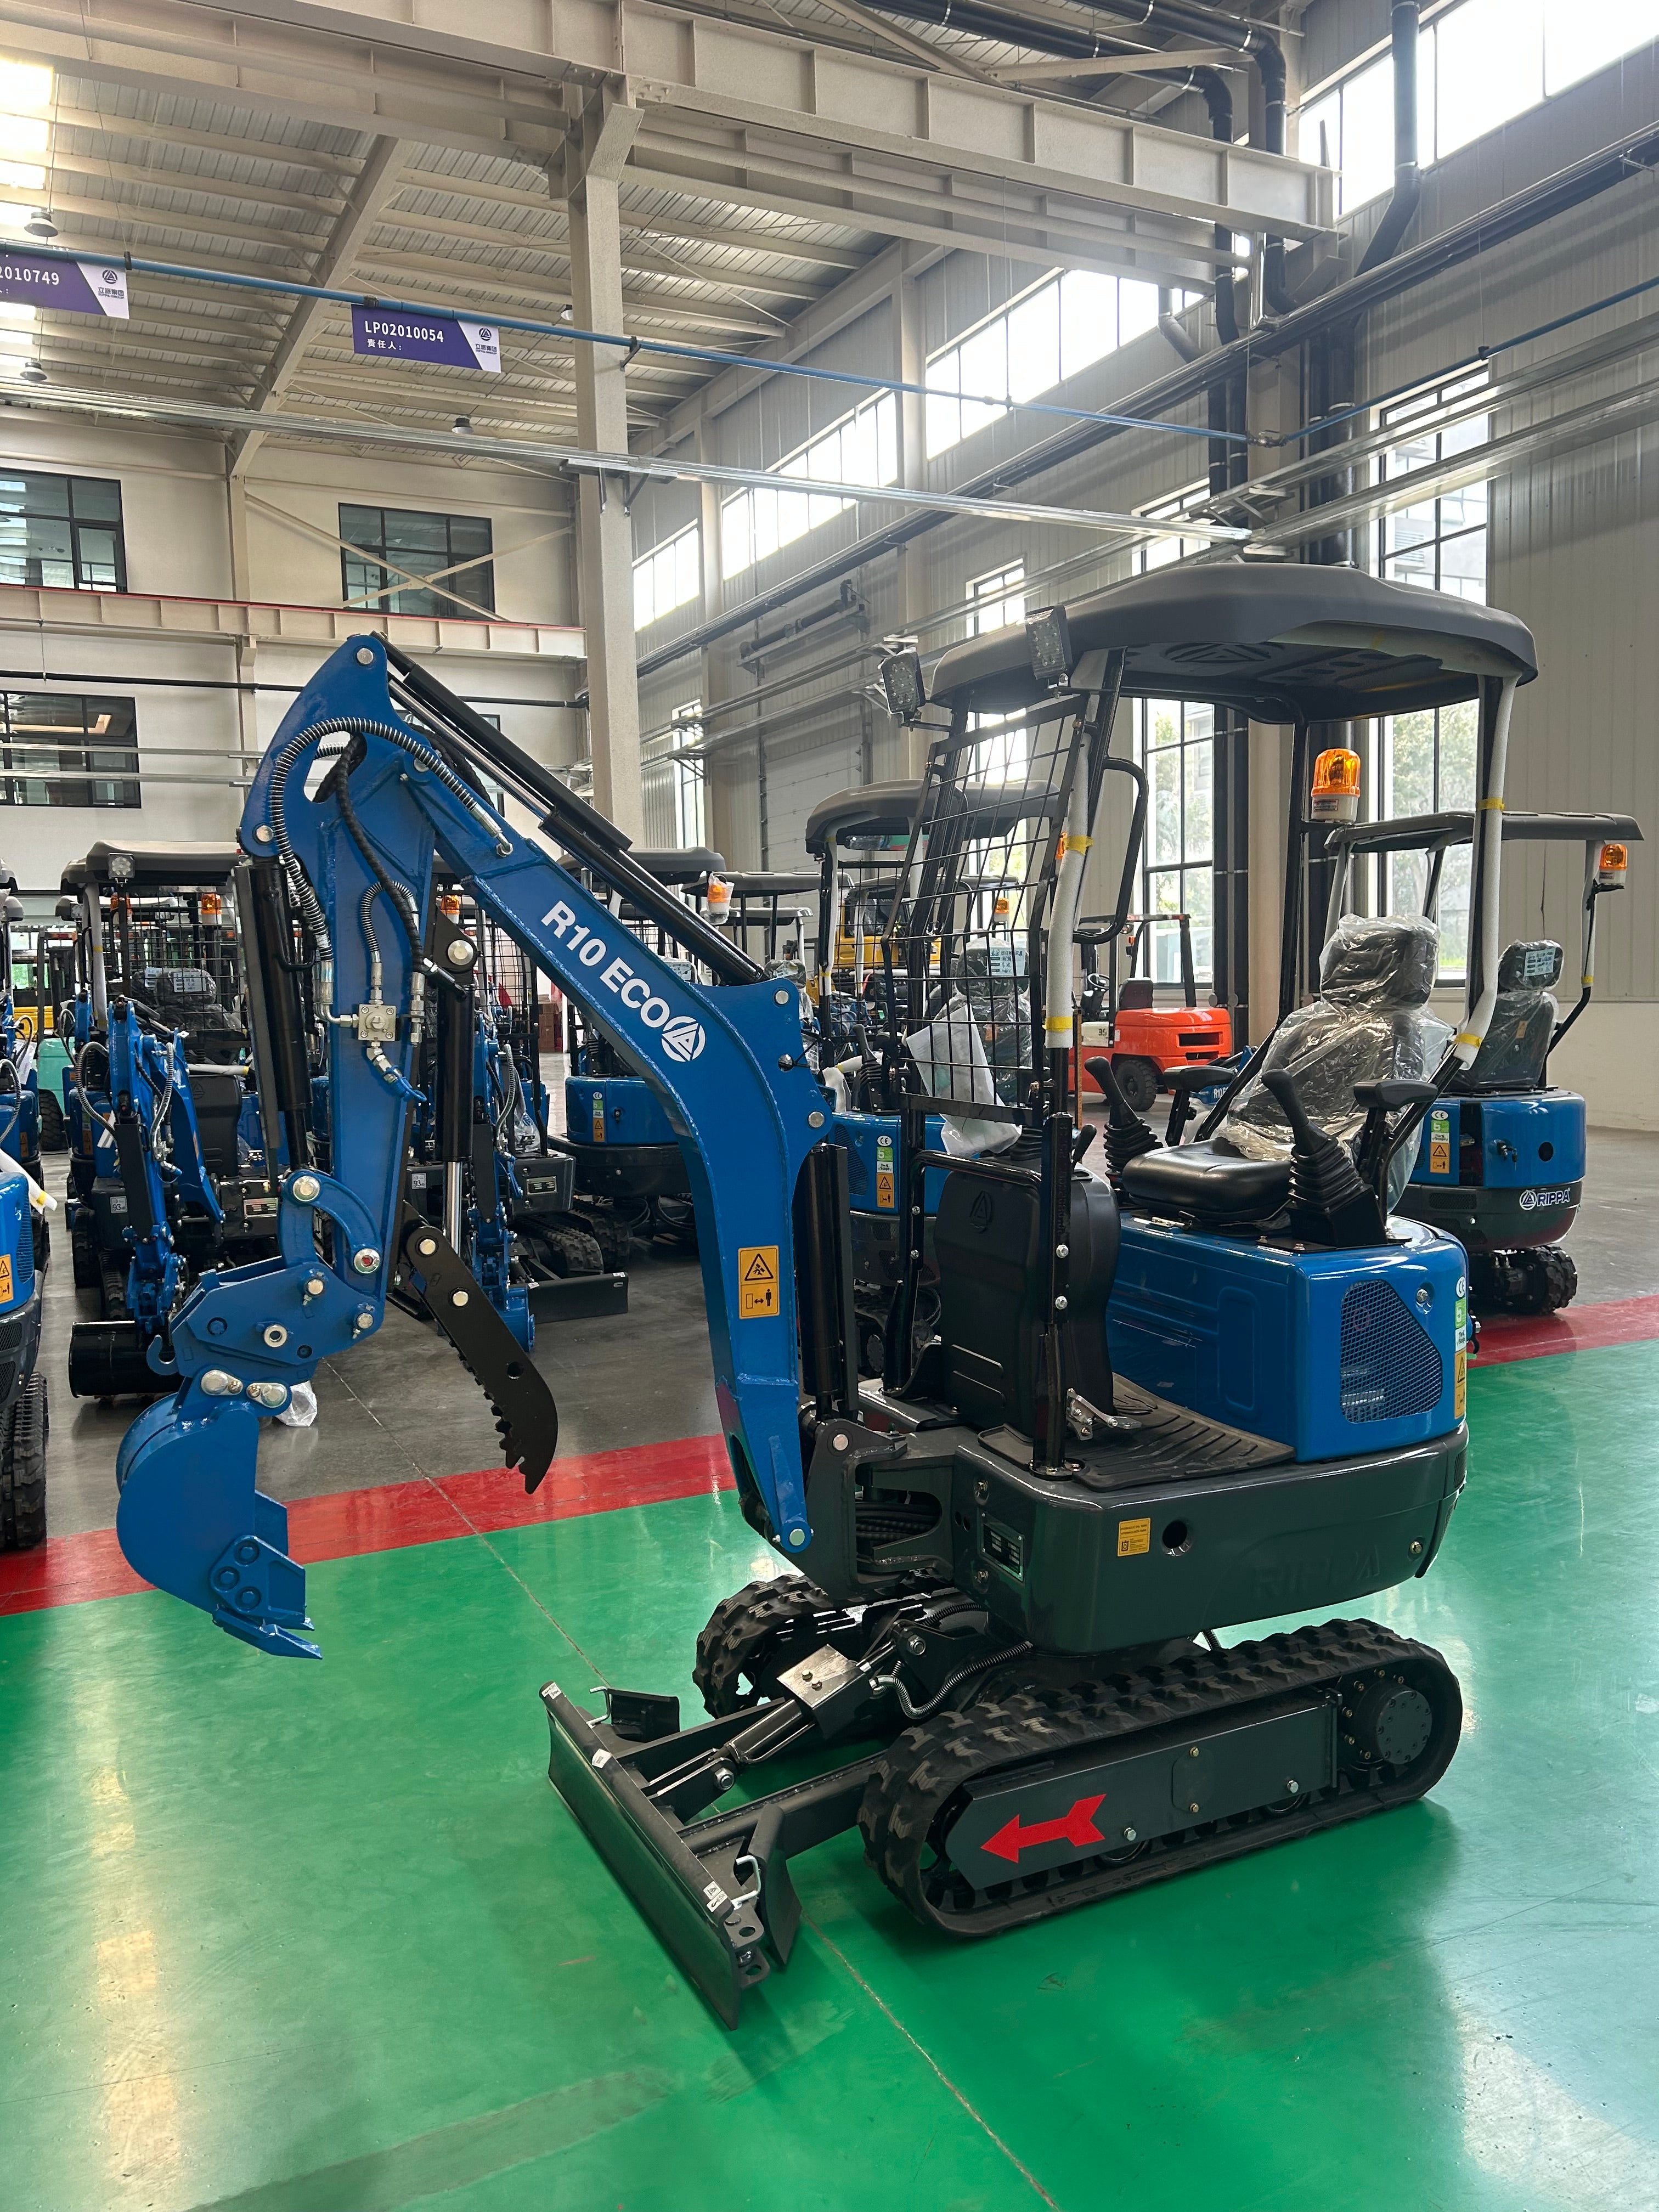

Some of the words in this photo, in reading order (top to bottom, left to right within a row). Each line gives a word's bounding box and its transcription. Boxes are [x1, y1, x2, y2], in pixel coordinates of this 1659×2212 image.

[364, 320, 444, 342] LP02010054
[541, 900, 606, 966] R10
[599, 957, 670, 1028] ECO
[1537, 1189, 1570, 1206] RIPPA
